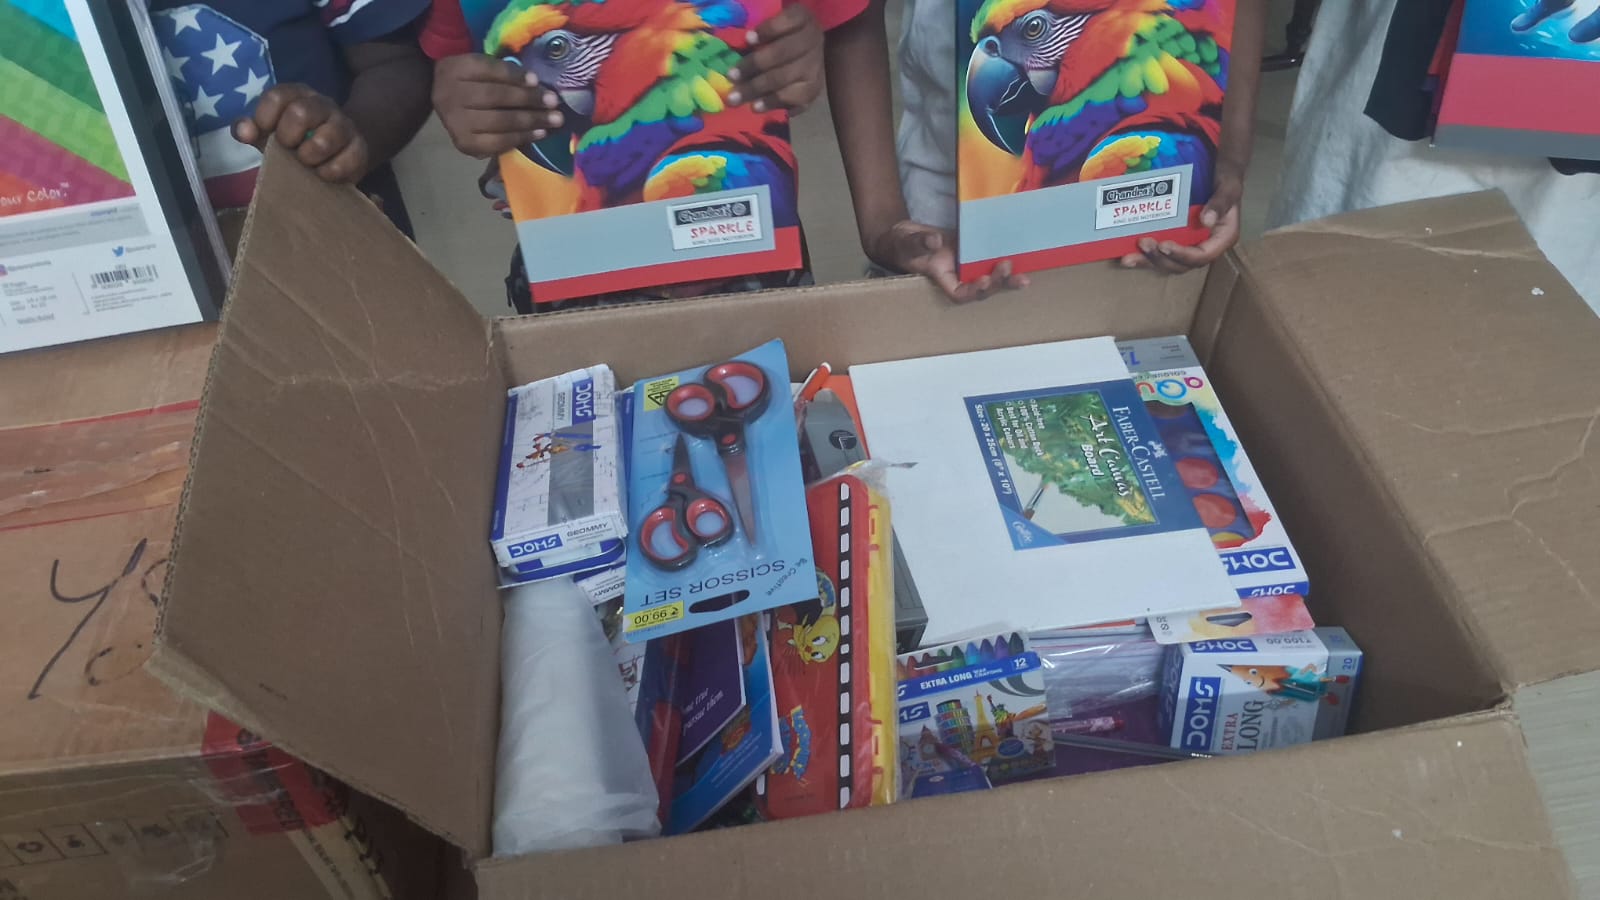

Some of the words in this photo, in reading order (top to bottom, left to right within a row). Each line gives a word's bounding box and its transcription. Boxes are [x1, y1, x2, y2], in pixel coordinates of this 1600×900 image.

[1113, 199, 1172, 218] SPARKLE
[690, 220, 755, 239] SPARKLE
[575, 383, 592, 418] DOMS
[1080, 413, 1116, 443] Art
[1081, 443, 1105, 477] Board
[1112, 406, 1166, 500] FABER-CASTELL
[511, 535, 557, 556] DOMS
[689, 560, 785, 595] SCISSOR
[640, 587, 682, 608] SET
[1013, 657, 1027, 668] 12
[920, 678, 948, 690] EXTRA
[948, 671, 973, 684] LONG
[1186, 680, 1214, 747] DOMS
[1236, 701, 1265, 751] LONG
[1221, 713, 1239, 751] EXTRA
